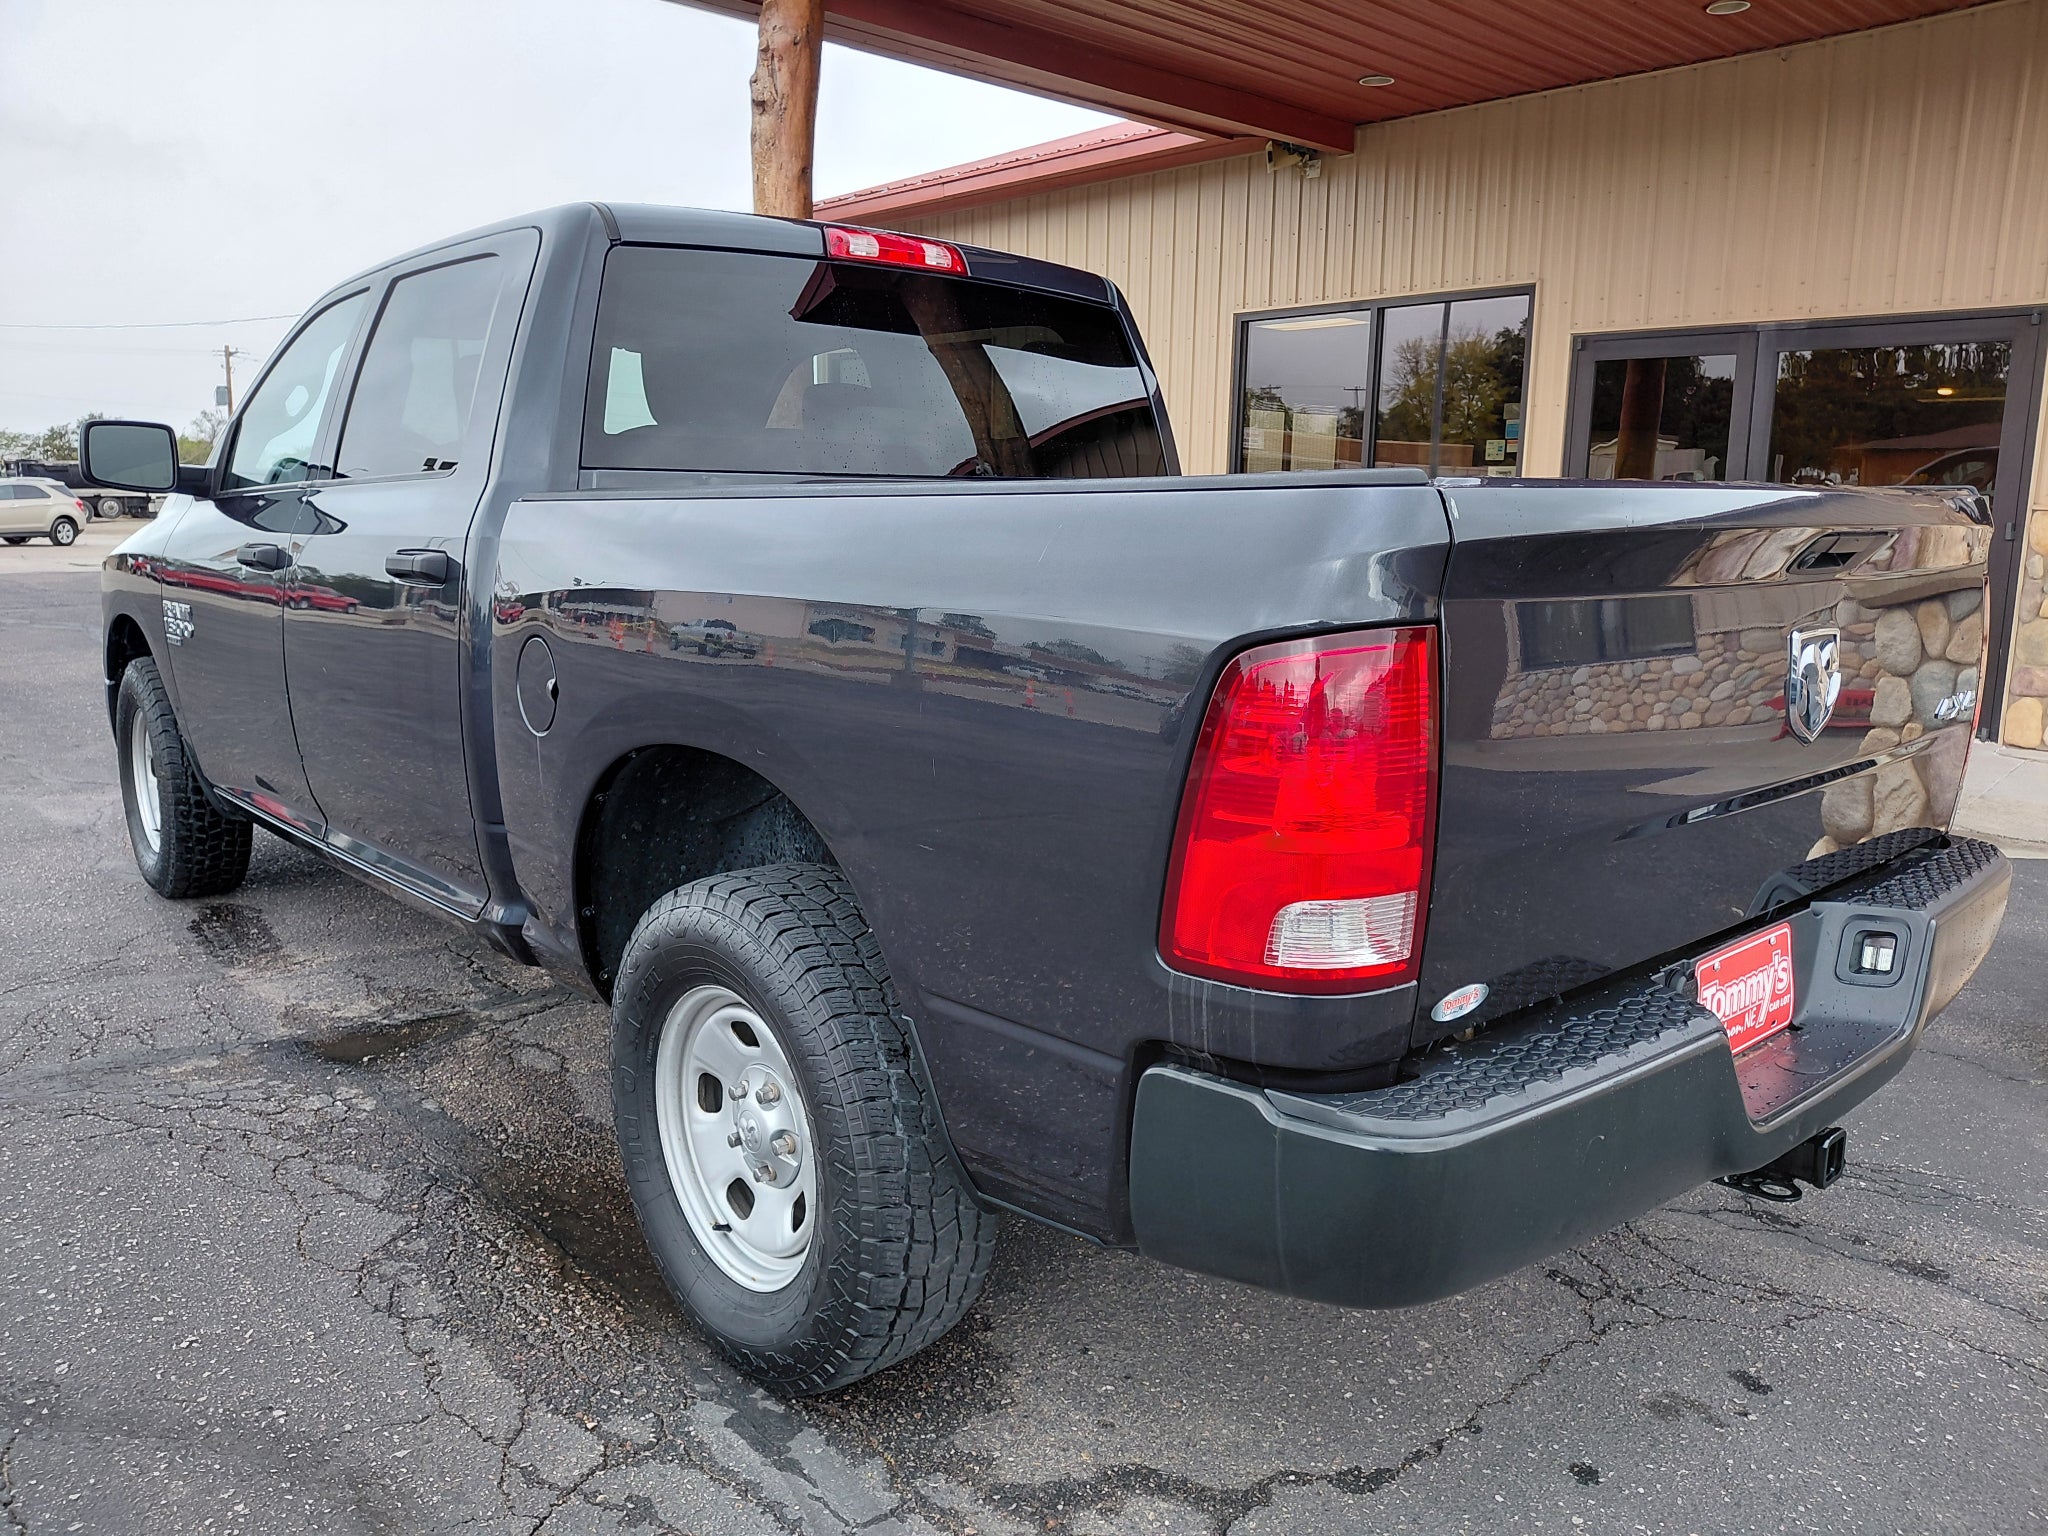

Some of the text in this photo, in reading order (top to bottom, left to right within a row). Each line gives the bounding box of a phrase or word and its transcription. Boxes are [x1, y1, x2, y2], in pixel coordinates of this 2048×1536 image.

[163, 616, 195, 638] 1500
[1443, 987, 1481, 1012] Tommy's
[1702, 949, 1790, 1028] Tommy's
[1769, 994, 1791, 1013] CAR LOT
[1744, 1006, 1757, 1032] NE
